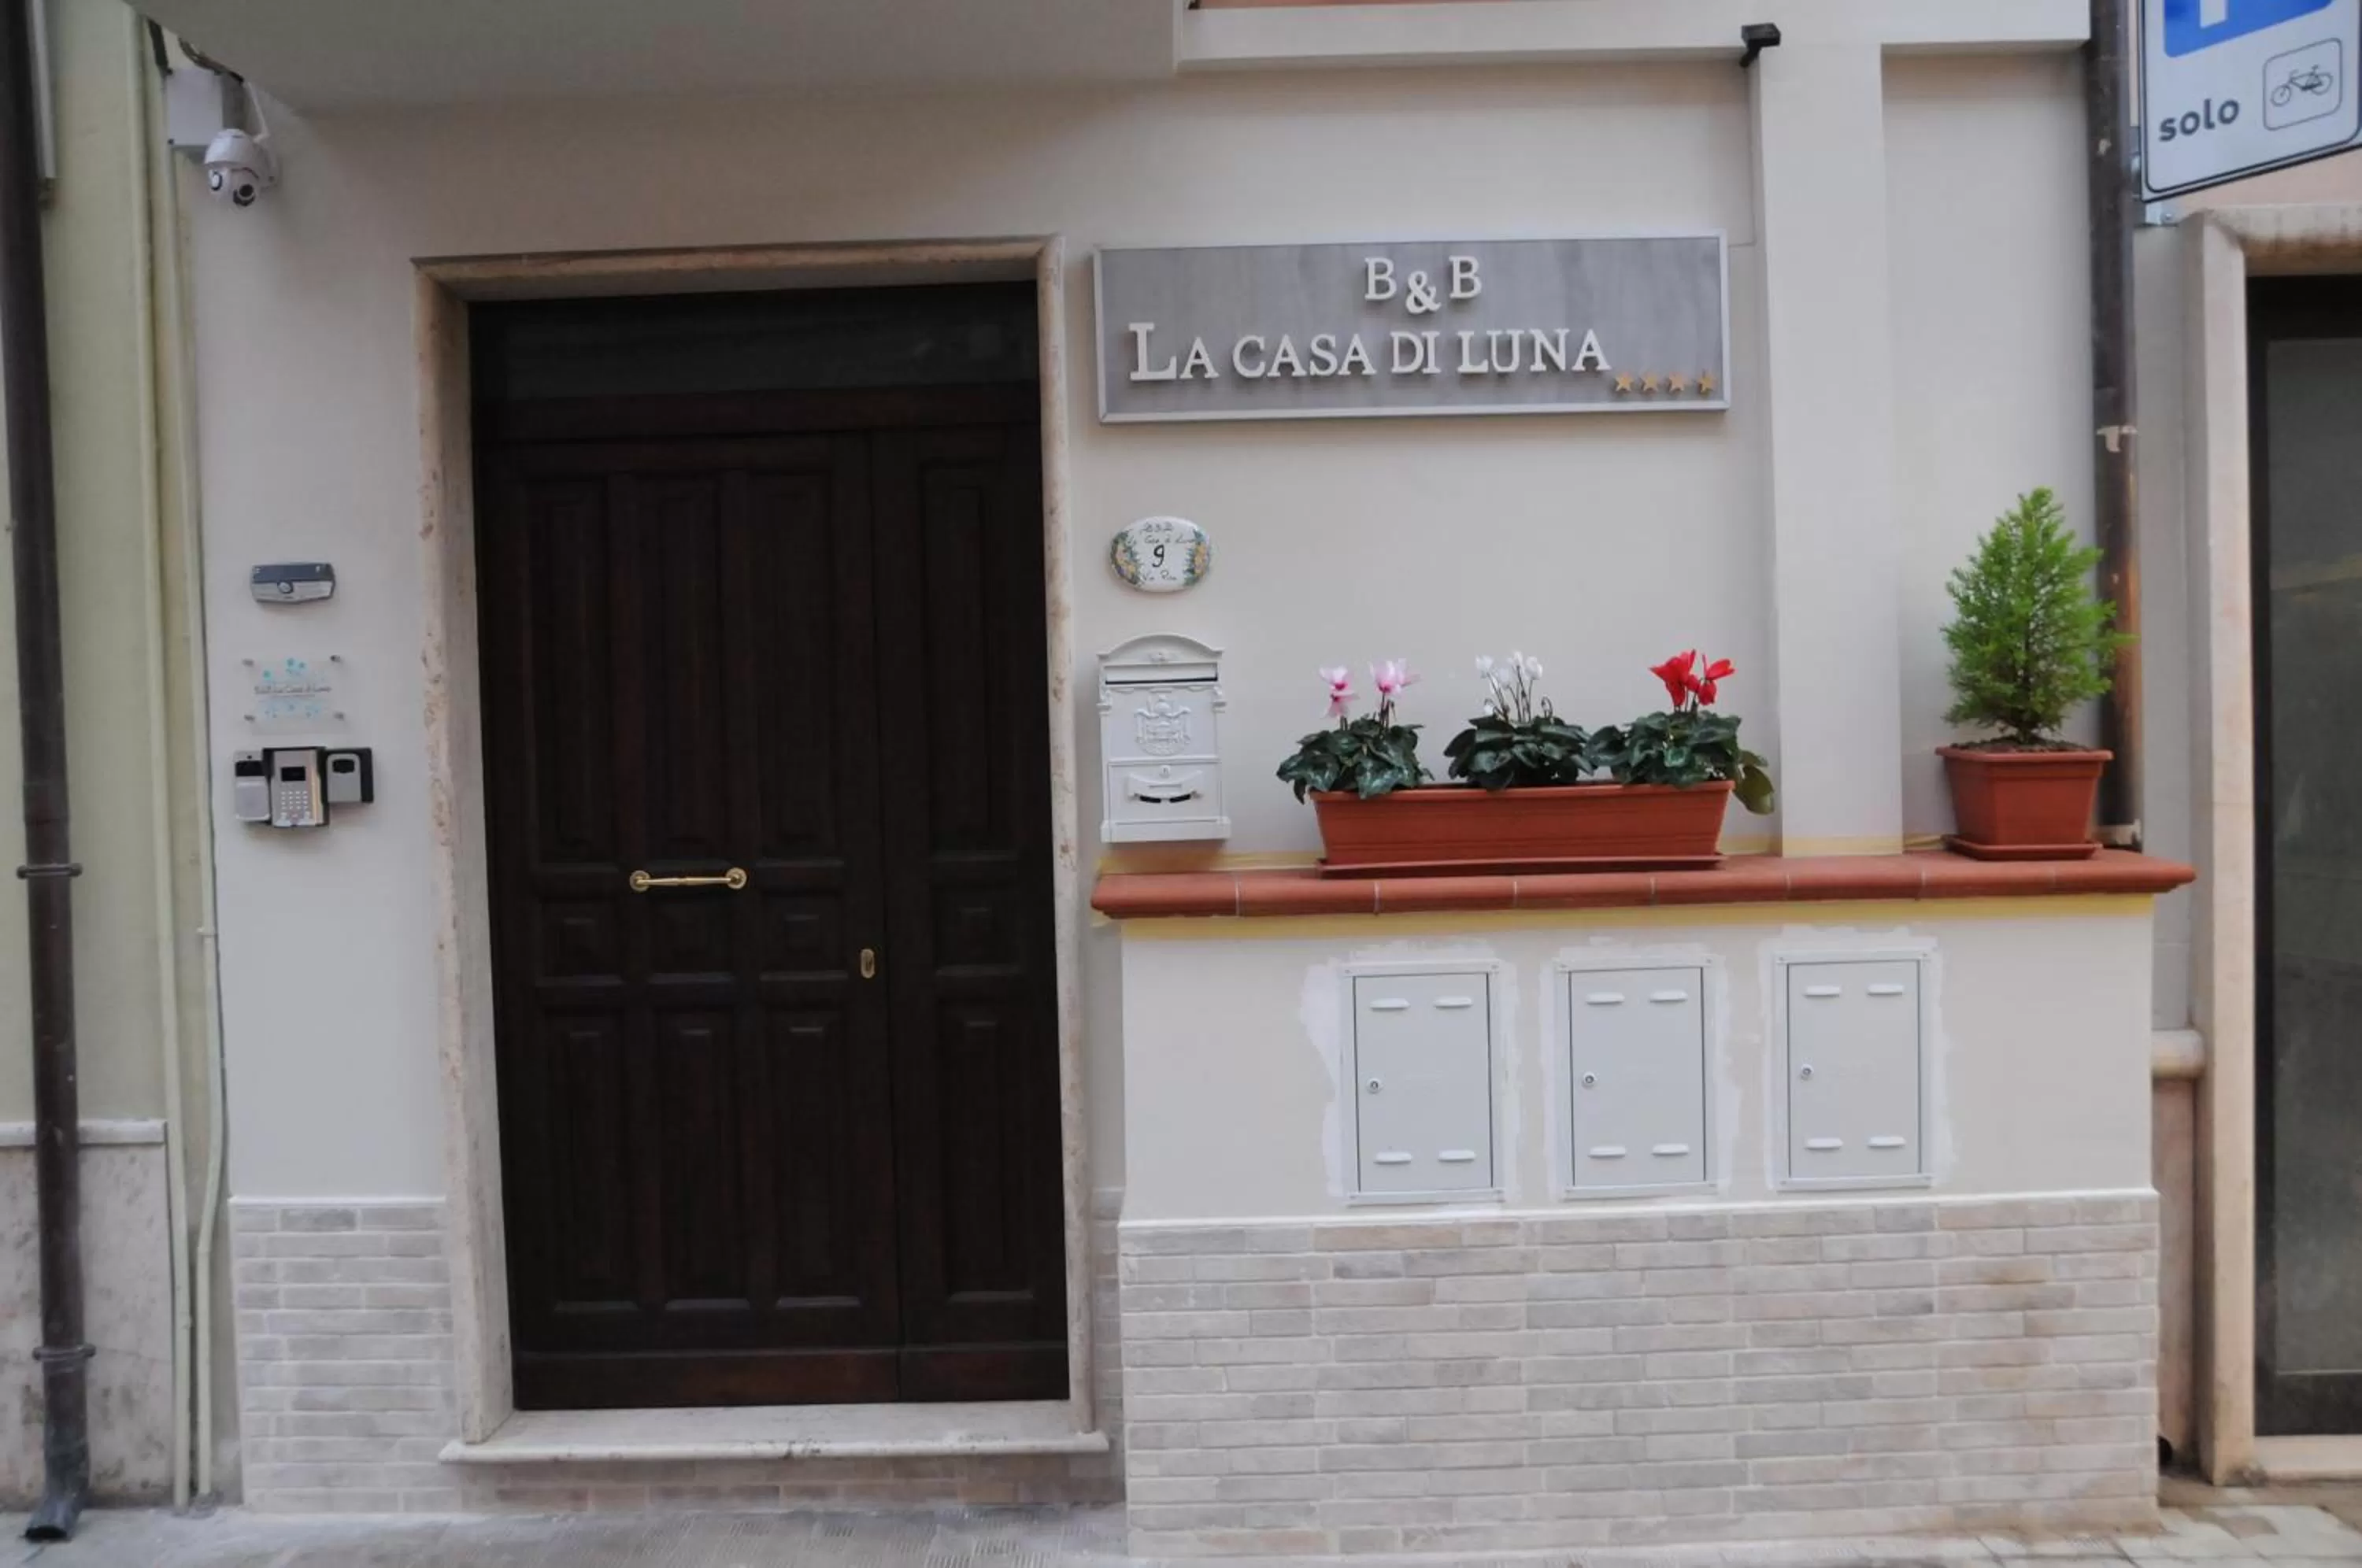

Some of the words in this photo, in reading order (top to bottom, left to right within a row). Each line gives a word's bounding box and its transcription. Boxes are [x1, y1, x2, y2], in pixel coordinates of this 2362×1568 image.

[2159, 98, 2239, 142] solo
[1129, 322, 1220, 380] LA
[1232, 333, 1377, 378] CASA
[1390, 330, 1442, 374] DI
[1457, 327, 1612, 374] LUNA
[1152, 544, 1164, 568] 9
